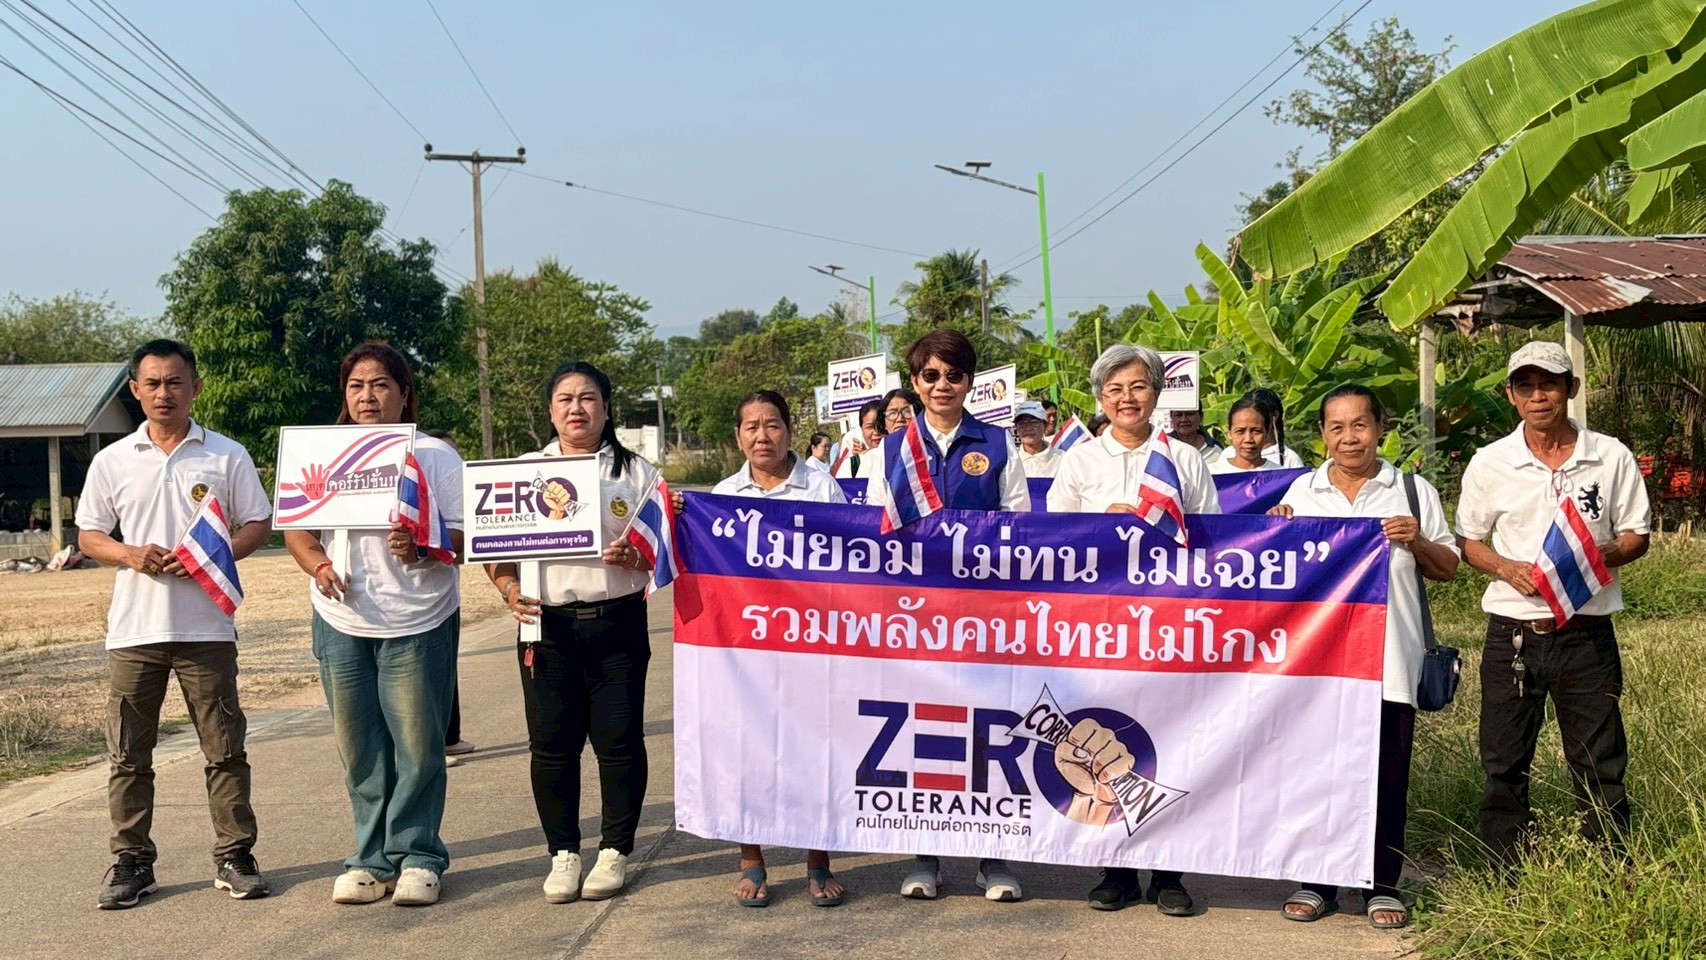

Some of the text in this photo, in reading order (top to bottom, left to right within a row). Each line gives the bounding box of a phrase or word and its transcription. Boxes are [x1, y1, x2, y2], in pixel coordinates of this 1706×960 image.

[475, 477, 578, 520] ZERO
[475, 514, 537, 525] TOLERANCE
[711, 507, 924, 577] “ไม่ยอม
[943, 521, 1098, 584] ไม่ทน
[741, 596, 1288, 664] รวมพลังคนไทยไม่โกง
[855, 699, 1157, 826] ZERO
[855, 789, 1032, 819] TOLERANCE
[855, 814, 1032, 838] คนไทยไม่ทนต่อการทุจริต
